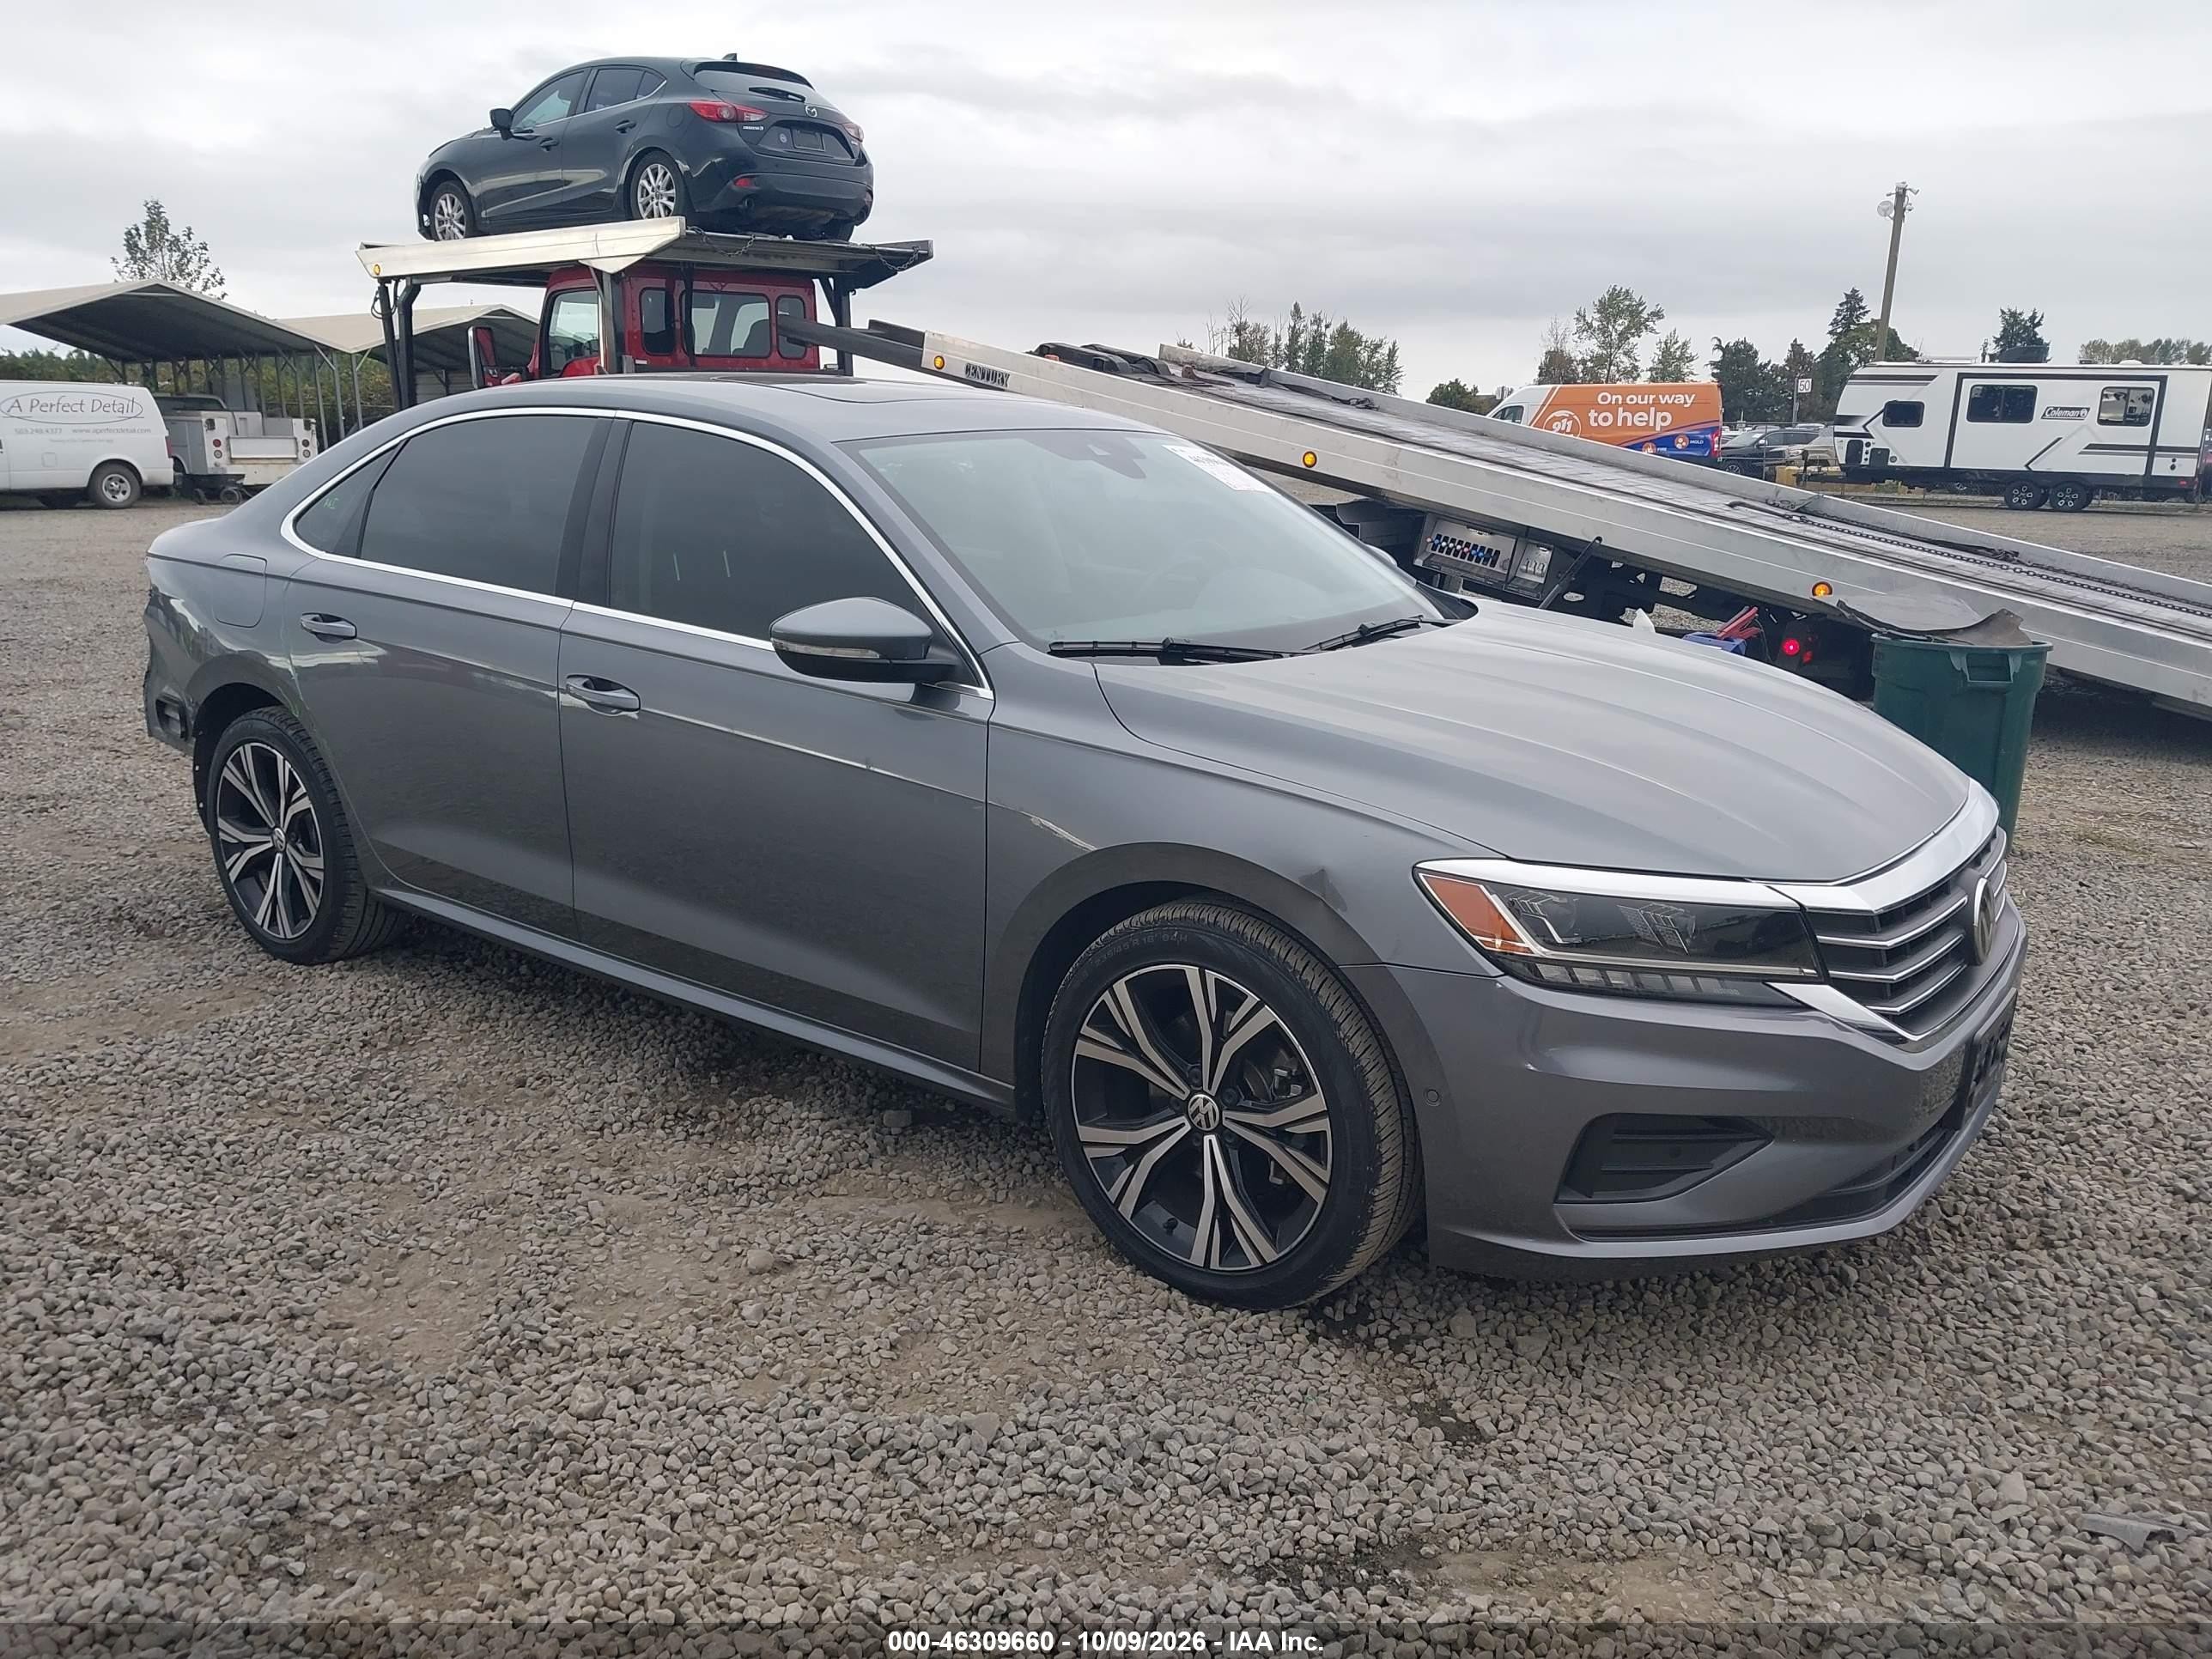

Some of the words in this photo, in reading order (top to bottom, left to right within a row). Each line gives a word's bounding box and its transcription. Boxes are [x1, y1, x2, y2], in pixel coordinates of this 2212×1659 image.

[964, 362, 1010, 387] CENTURY
[1799, 380, 1811, 392] 50
[7, 398, 22, 413] A
[29, 395, 86, 413] Perfect
[91, 397, 135, 415] Detail
[1597, 392, 1622, 404] On
[1626, 394, 1656, 404] our
[1659, 394, 1695, 408] way
[1589, 409, 1613, 427] to
[1617, 406, 1673, 431] help
[2045, 407, 2080, 417] Coleman
[1552, 418, 1573, 434] 911
